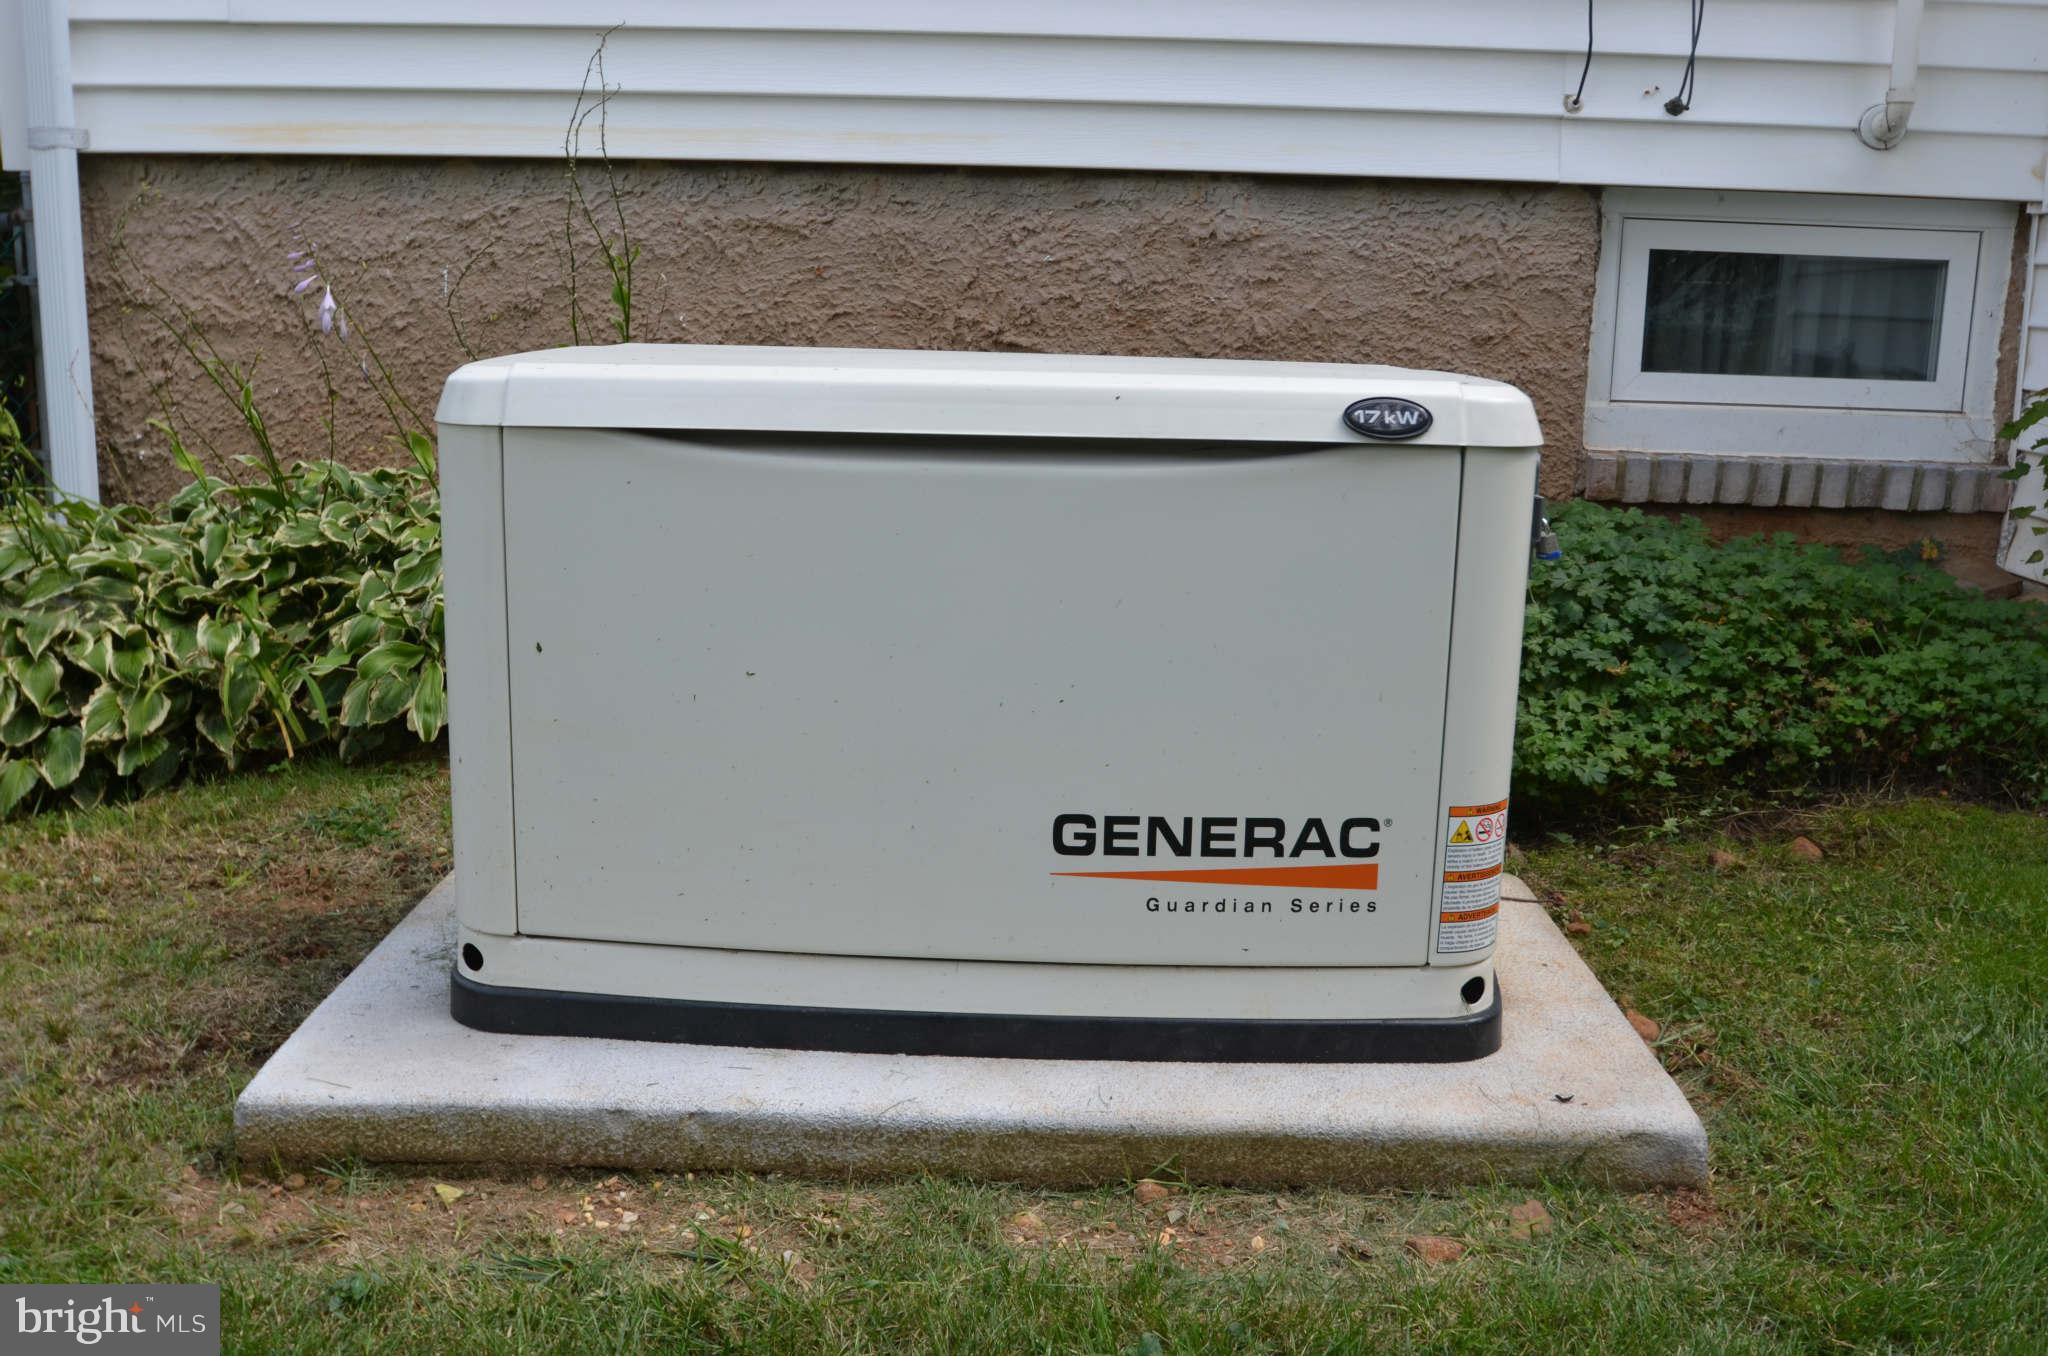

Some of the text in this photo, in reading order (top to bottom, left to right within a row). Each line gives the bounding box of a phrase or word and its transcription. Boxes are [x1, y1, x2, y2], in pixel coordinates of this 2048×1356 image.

[1353, 409, 1420, 425] 17 kW
[1146, 896, 1378, 914] Guardian Series
